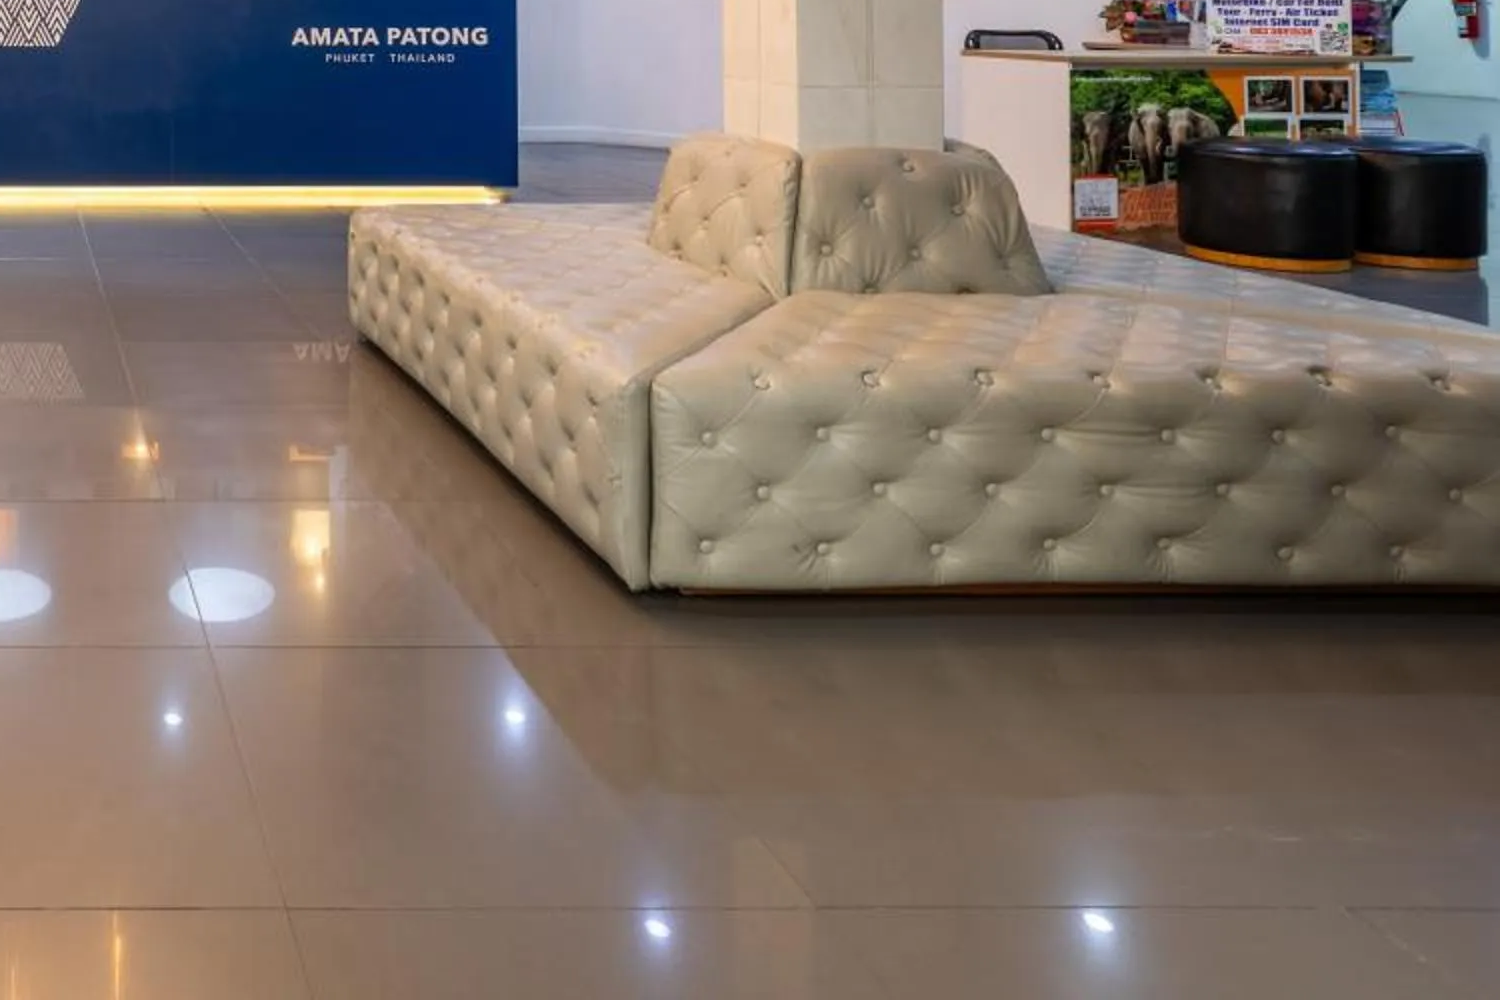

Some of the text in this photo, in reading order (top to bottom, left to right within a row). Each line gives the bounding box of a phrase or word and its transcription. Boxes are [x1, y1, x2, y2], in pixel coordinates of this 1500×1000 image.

[1224, 18, 1320, 27] Internet SIM Card
[291, 26, 489, 46] AMATA PATONG
[325, 53, 456, 63] PHUKET THAILAND
